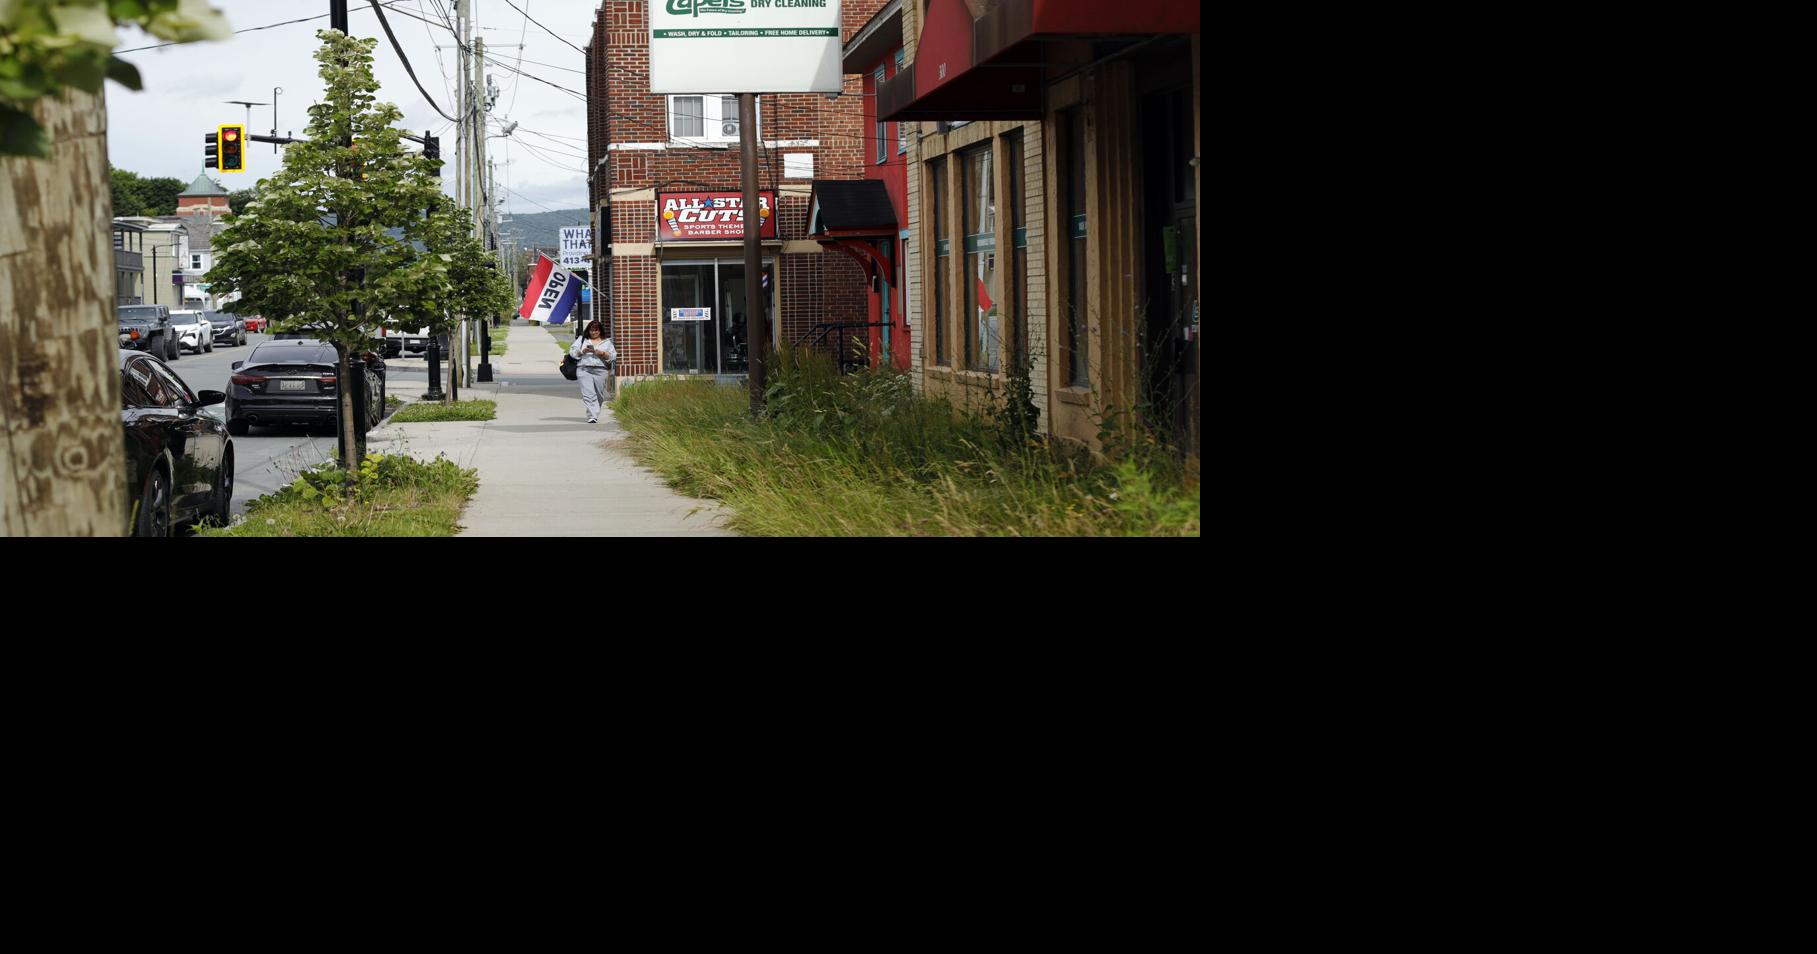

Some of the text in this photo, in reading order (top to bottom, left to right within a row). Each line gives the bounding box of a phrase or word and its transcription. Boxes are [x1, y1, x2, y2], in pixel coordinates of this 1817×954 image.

[751, 0, 827, 8] DRY CLEANING
[663, 197, 770, 213] ALL STR
